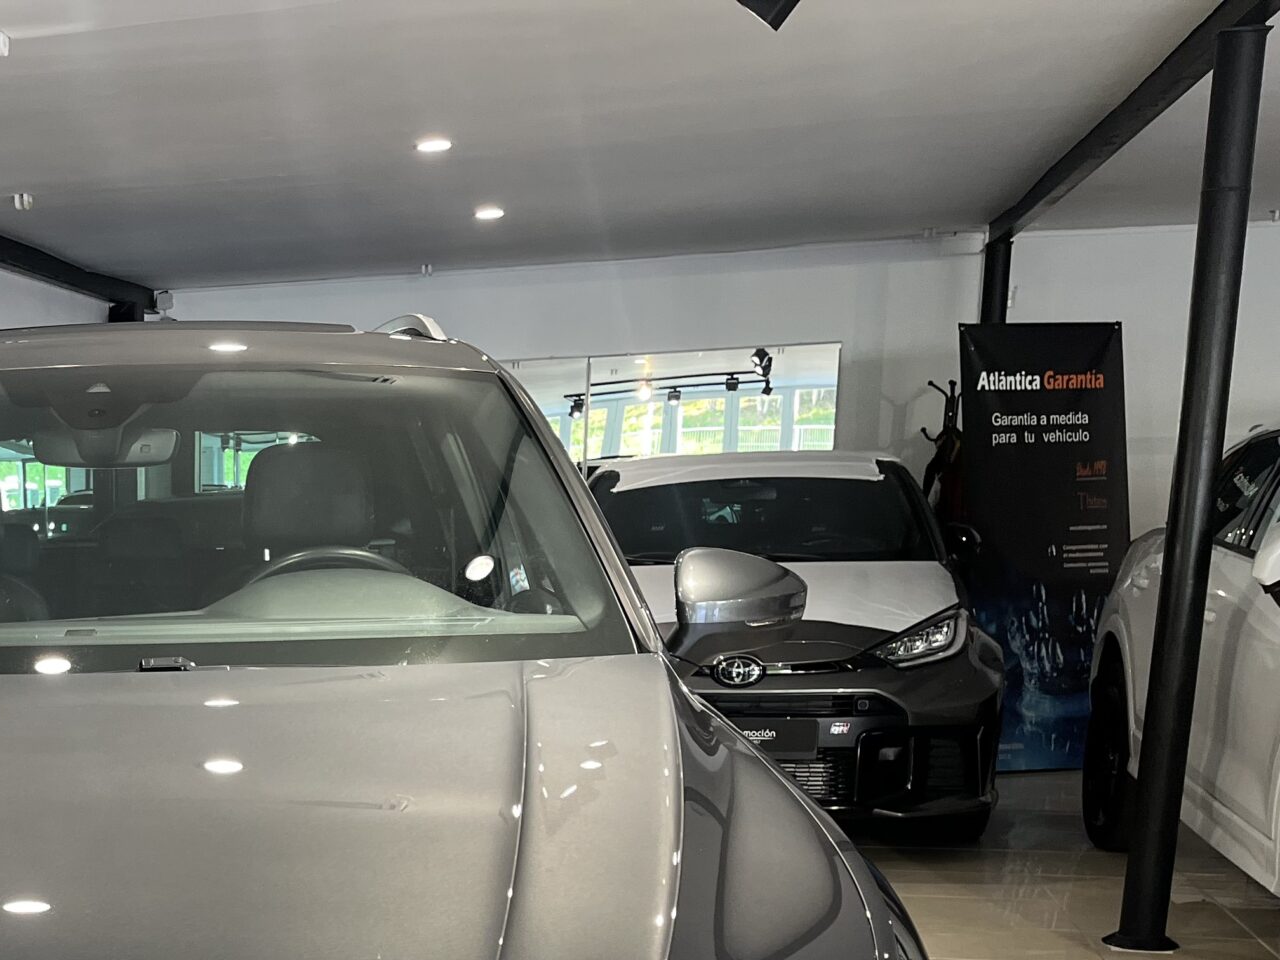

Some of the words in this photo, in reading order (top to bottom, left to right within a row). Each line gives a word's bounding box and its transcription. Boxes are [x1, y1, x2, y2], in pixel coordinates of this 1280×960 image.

[977, 371, 1040, 391] Atlántica
[1040, 414, 1048, 425] a
[1050, 411, 1089, 425] medida
[992, 433, 1017, 447] para
[1024, 430, 1035, 443] tu
[1042, 428, 1090, 443] vehículo
[743, 729, 776, 738] moción
